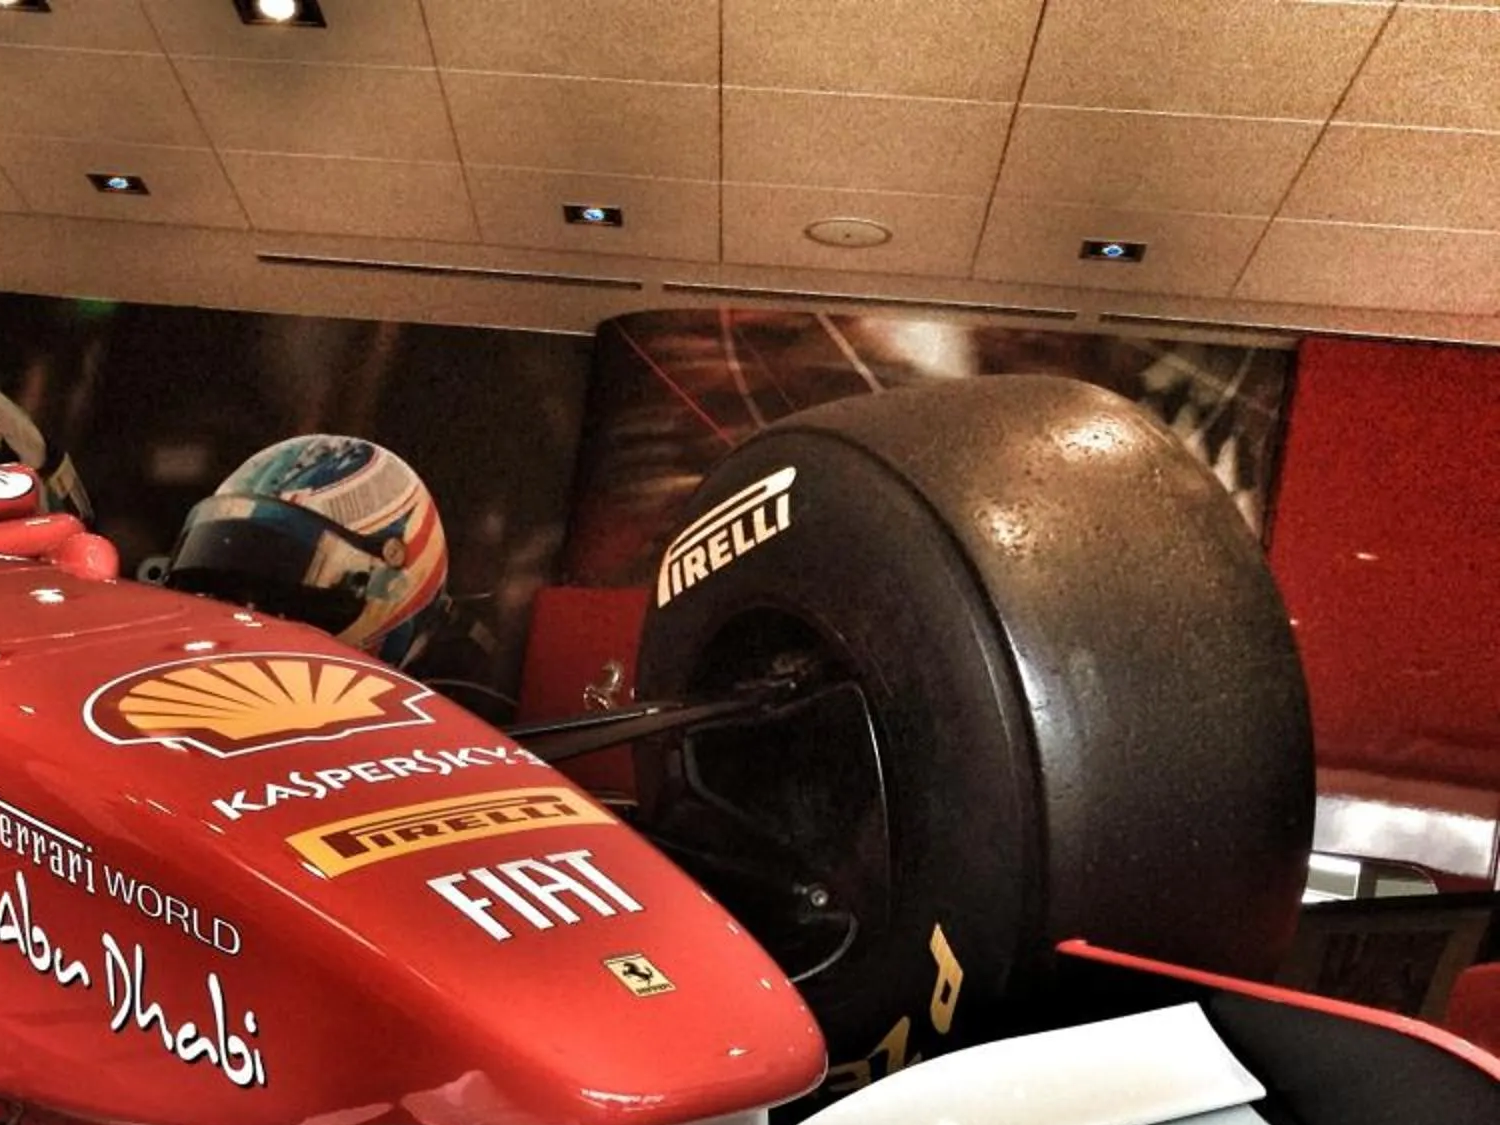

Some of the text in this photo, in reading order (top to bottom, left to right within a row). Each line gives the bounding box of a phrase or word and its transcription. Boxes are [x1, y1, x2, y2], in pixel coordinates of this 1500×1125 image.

[657, 465, 798, 609] PIRELLI
[320, 794, 580, 860] PIRELLI
[103, 864, 242, 956] WORLD
[426, 848, 645, 943] FIAT
[102, 931, 266, 1087] Dhabi
